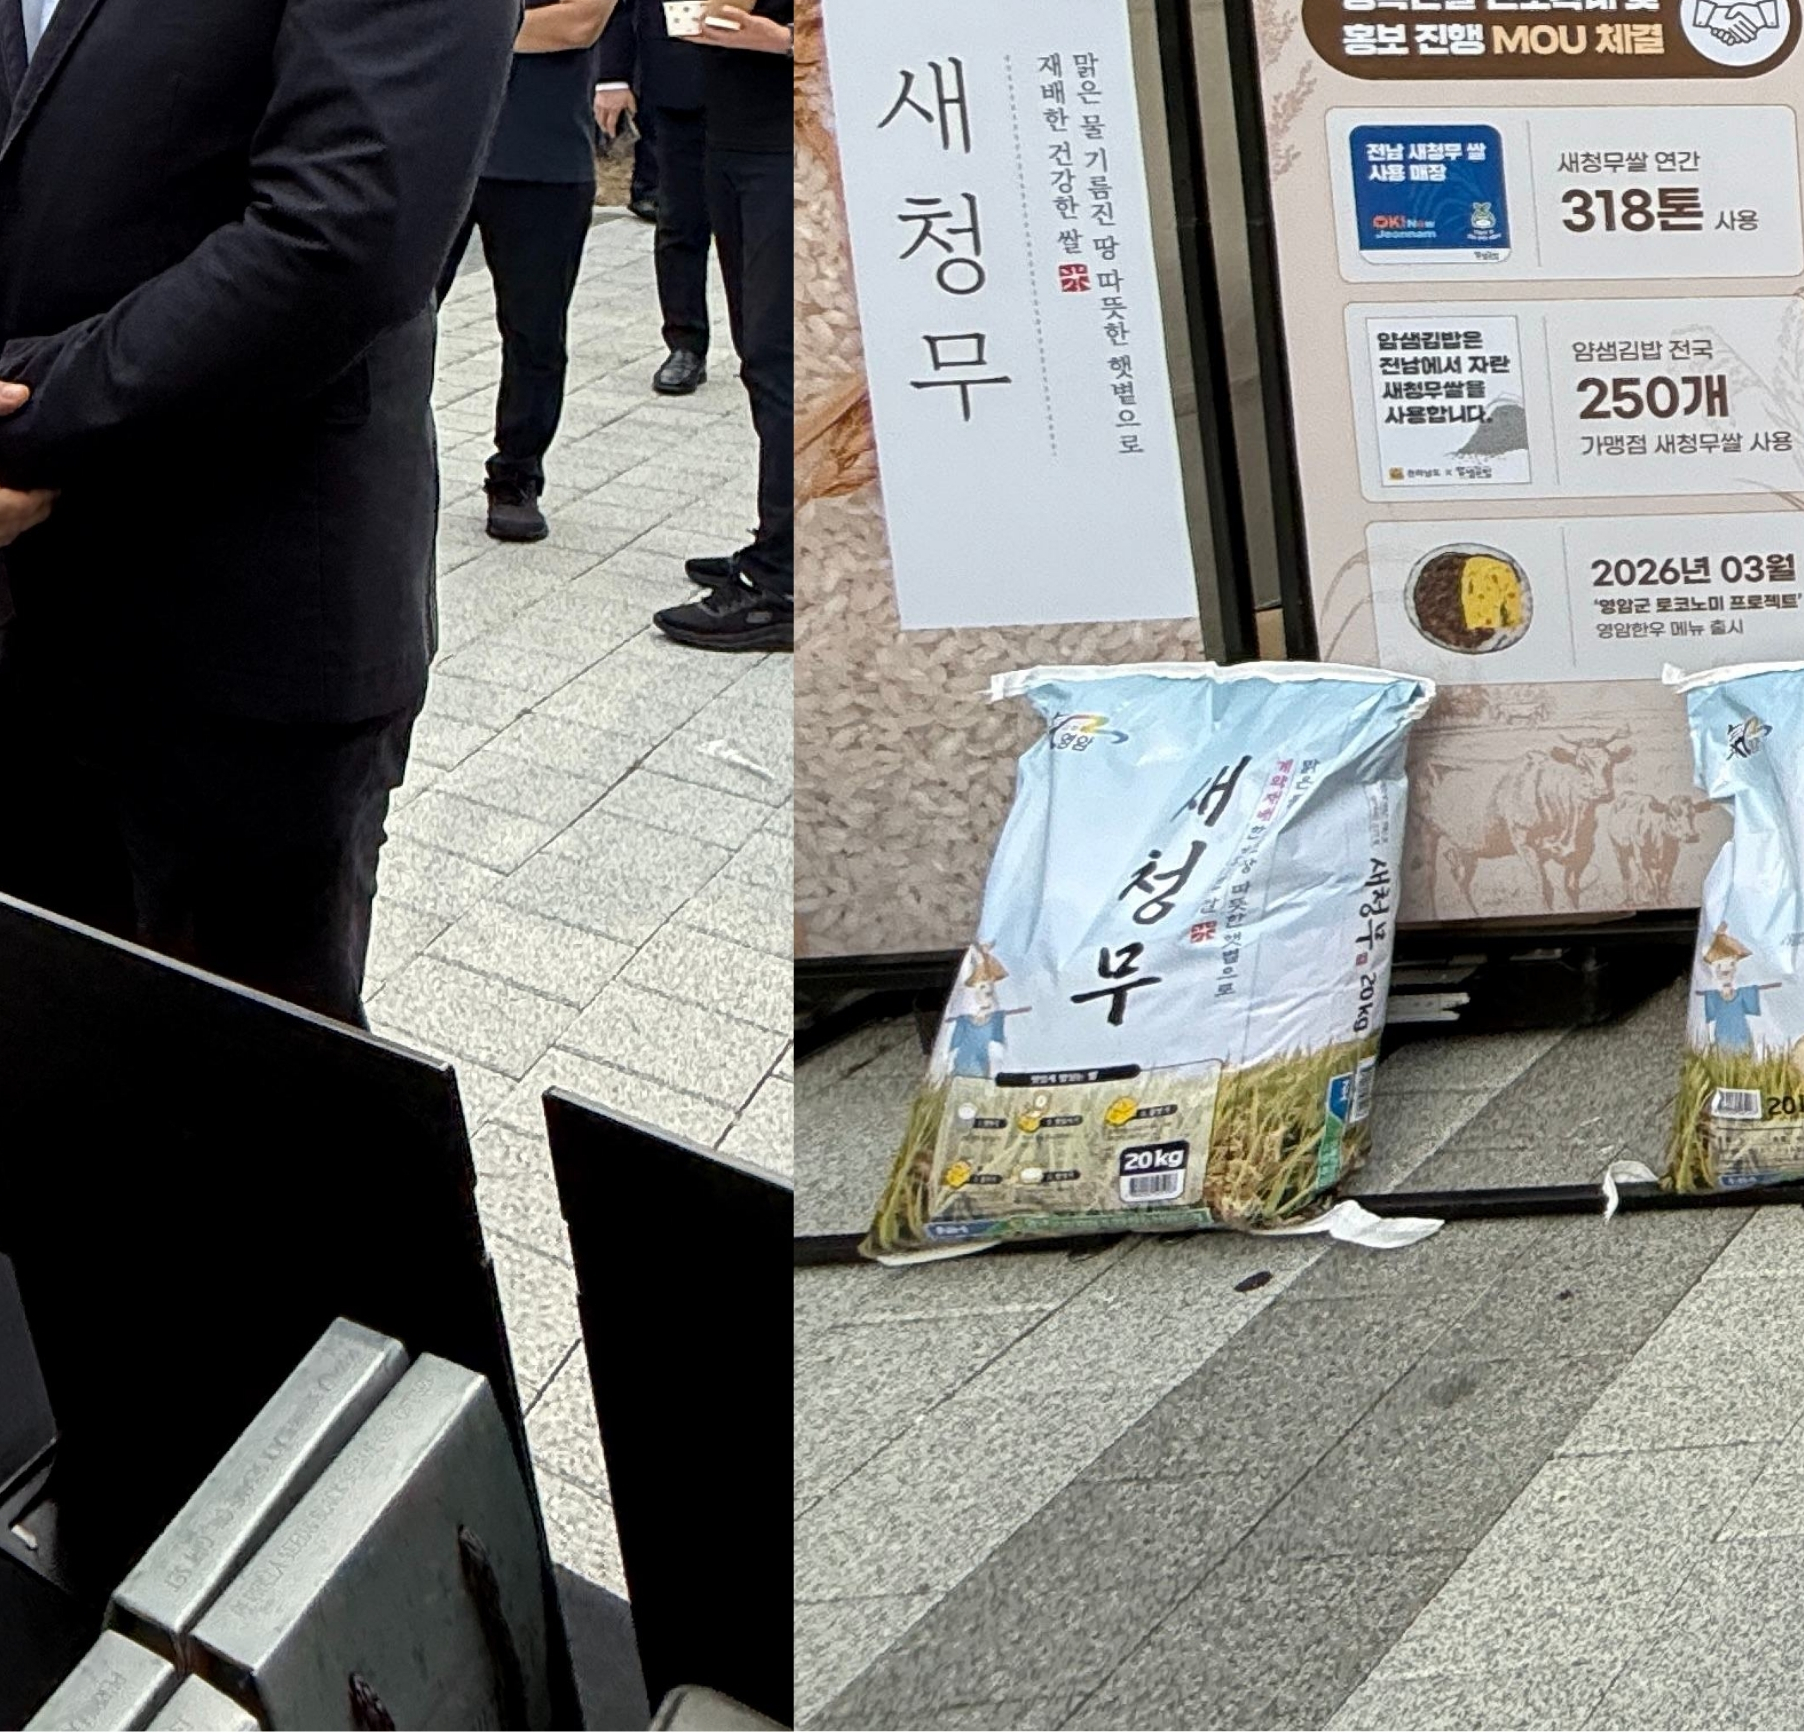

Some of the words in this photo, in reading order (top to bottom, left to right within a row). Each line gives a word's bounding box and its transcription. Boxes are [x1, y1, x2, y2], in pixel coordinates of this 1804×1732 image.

[1342, 24, 1408, 56] 홍보
[1415, 24, 1483, 56] 진행
[1493, 24, 1586, 55] MOU
[1596, 23, 1664, 55] 체결
[1073, 53, 1100, 106] 맑은
[1038, 52, 1069, 135] 재배한
[1079, 113, 1106, 142] 물
[1366, 143, 1404, 161] 전남
[1409, 143, 1462, 161] 새청무
[1467, 142, 1487, 161] 쌀
[1558, 152, 1648, 174] 새청무쌀
[1655, 150, 1700, 173] 연간
[1047, 140, 1080, 221] 건강한
[1083, 145, 1116, 228] 기름진
[1369, 164, 1405, 182] 사용
[1410, 164, 1447, 182] 매장
[1562, 187, 1703, 233] 318톤
[1715, 209, 1760, 232] 사용
[1057, 226, 1083, 257] 쌀
[1092, 234, 1121, 260] 땅
[1096, 268, 1131, 347] 따뜻한
[1573, 340, 1663, 362] 얌샘김밥
[1669, 339, 1713, 360] 전국
[1380, 357, 1462, 375] 전남에서
[1468, 355, 1510, 373] 자란
[1383, 381, 1486, 399] 새청무쌀을
[1577, 374, 1728, 419] 250개
[1107, 352, 1146, 456] 햇볕으로
[1385, 405, 1492, 424] 사용합니다.
[1581, 434, 1648, 456] 가맹점
[1655, 432, 1743, 455] 새청무쌀
[1751, 431, 1793, 452] 사용
[1592, 556, 1712, 587] 2026년
[1721, 554, 1796, 583] 03월
[1656, 595, 1725, 613] 로코노미
[1597, 621, 1664, 639] 영암한우
[1671, 620, 1704, 637] 메뉴
[1710, 618, 1743, 636] 출시
[1123, 1148, 1185, 1170] 20kg
